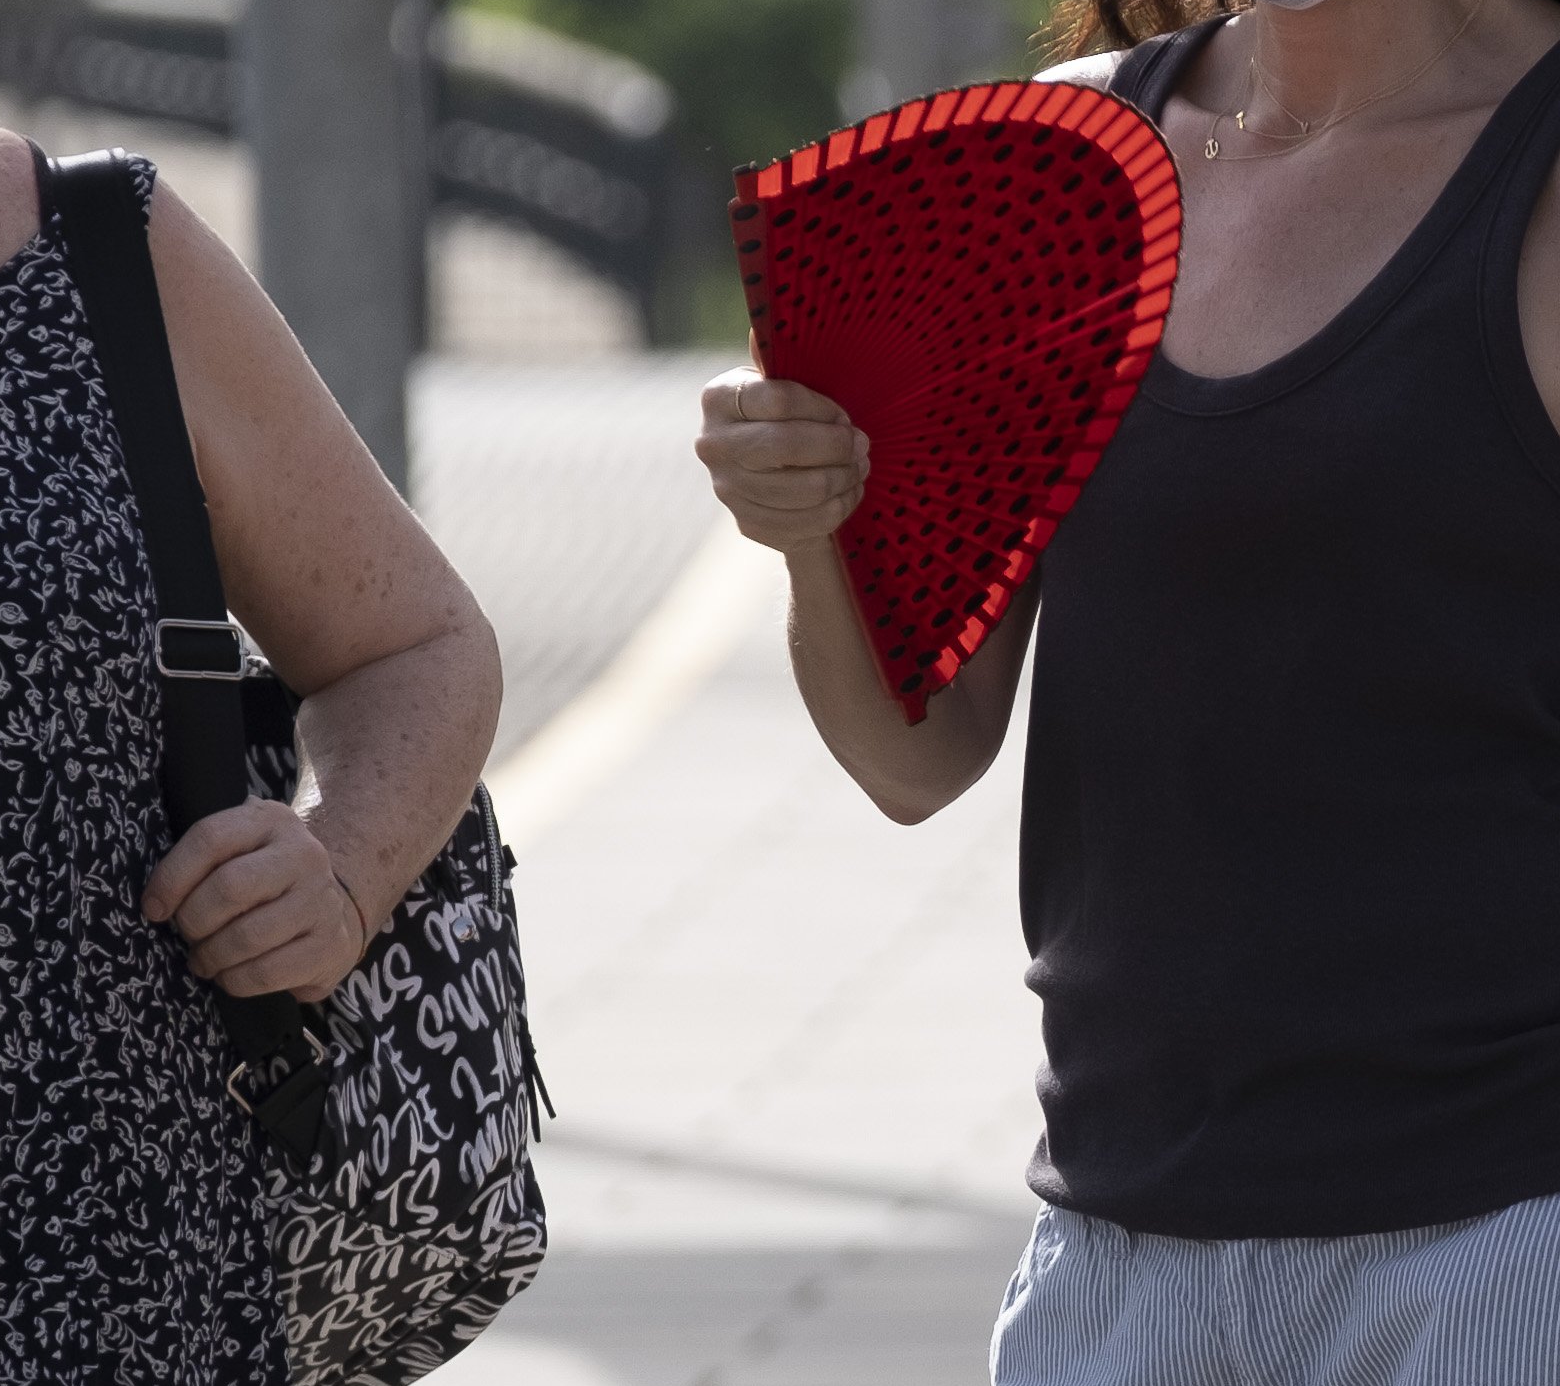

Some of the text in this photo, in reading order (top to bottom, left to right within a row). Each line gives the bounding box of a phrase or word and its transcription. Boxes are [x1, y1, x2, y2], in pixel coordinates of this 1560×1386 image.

[335, 1083, 455, 1210] MORE
[275, 1244, 405, 1316] FUN
[287, 1283, 395, 1345] ORE
